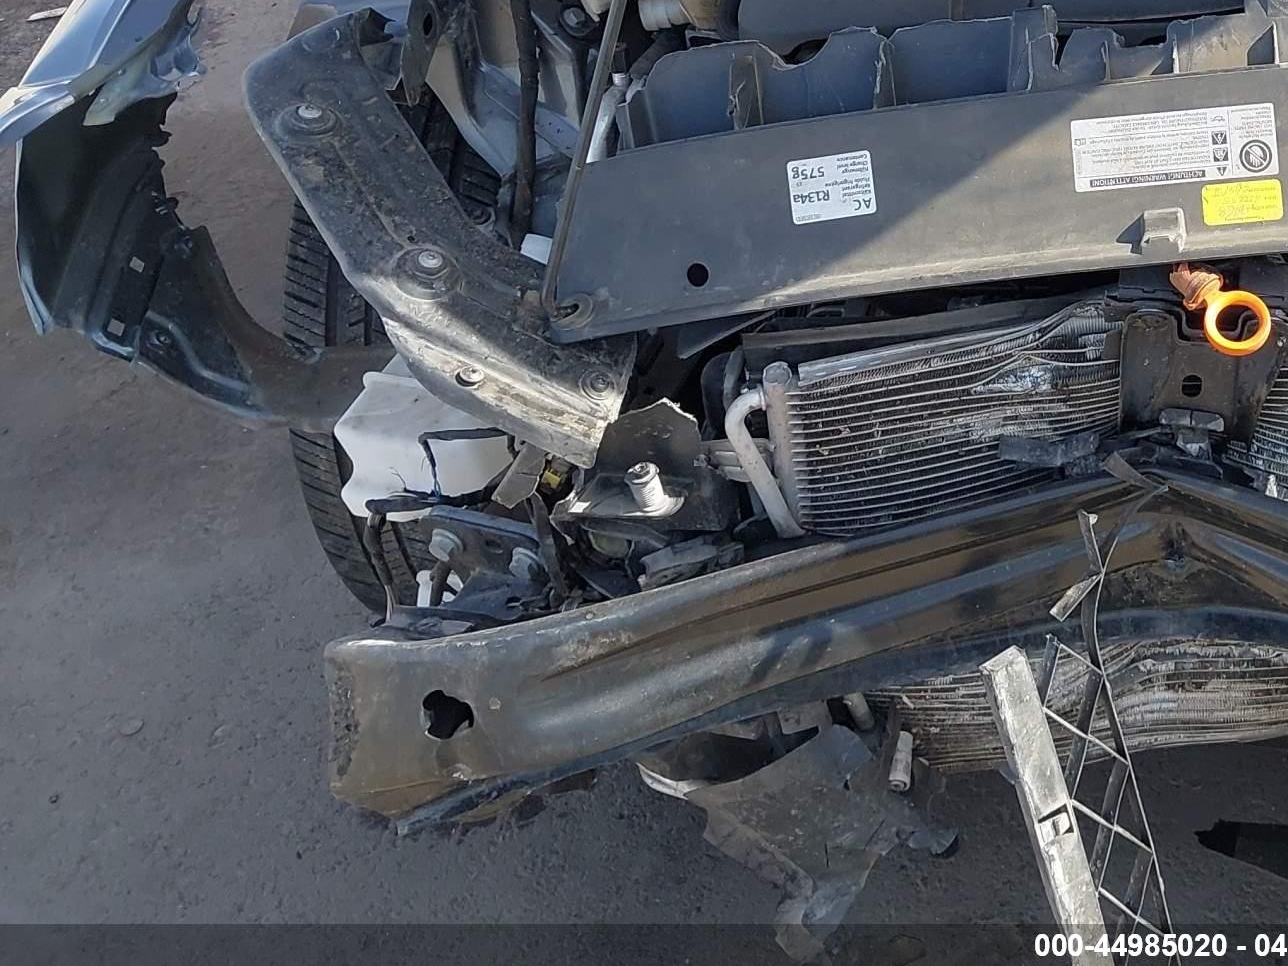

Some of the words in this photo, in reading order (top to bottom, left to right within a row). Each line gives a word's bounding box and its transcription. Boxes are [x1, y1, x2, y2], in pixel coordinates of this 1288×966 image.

[791, 166, 825, 180] 575g
[793, 189, 830, 204] R134a
[853, 197, 872, 211] AC
